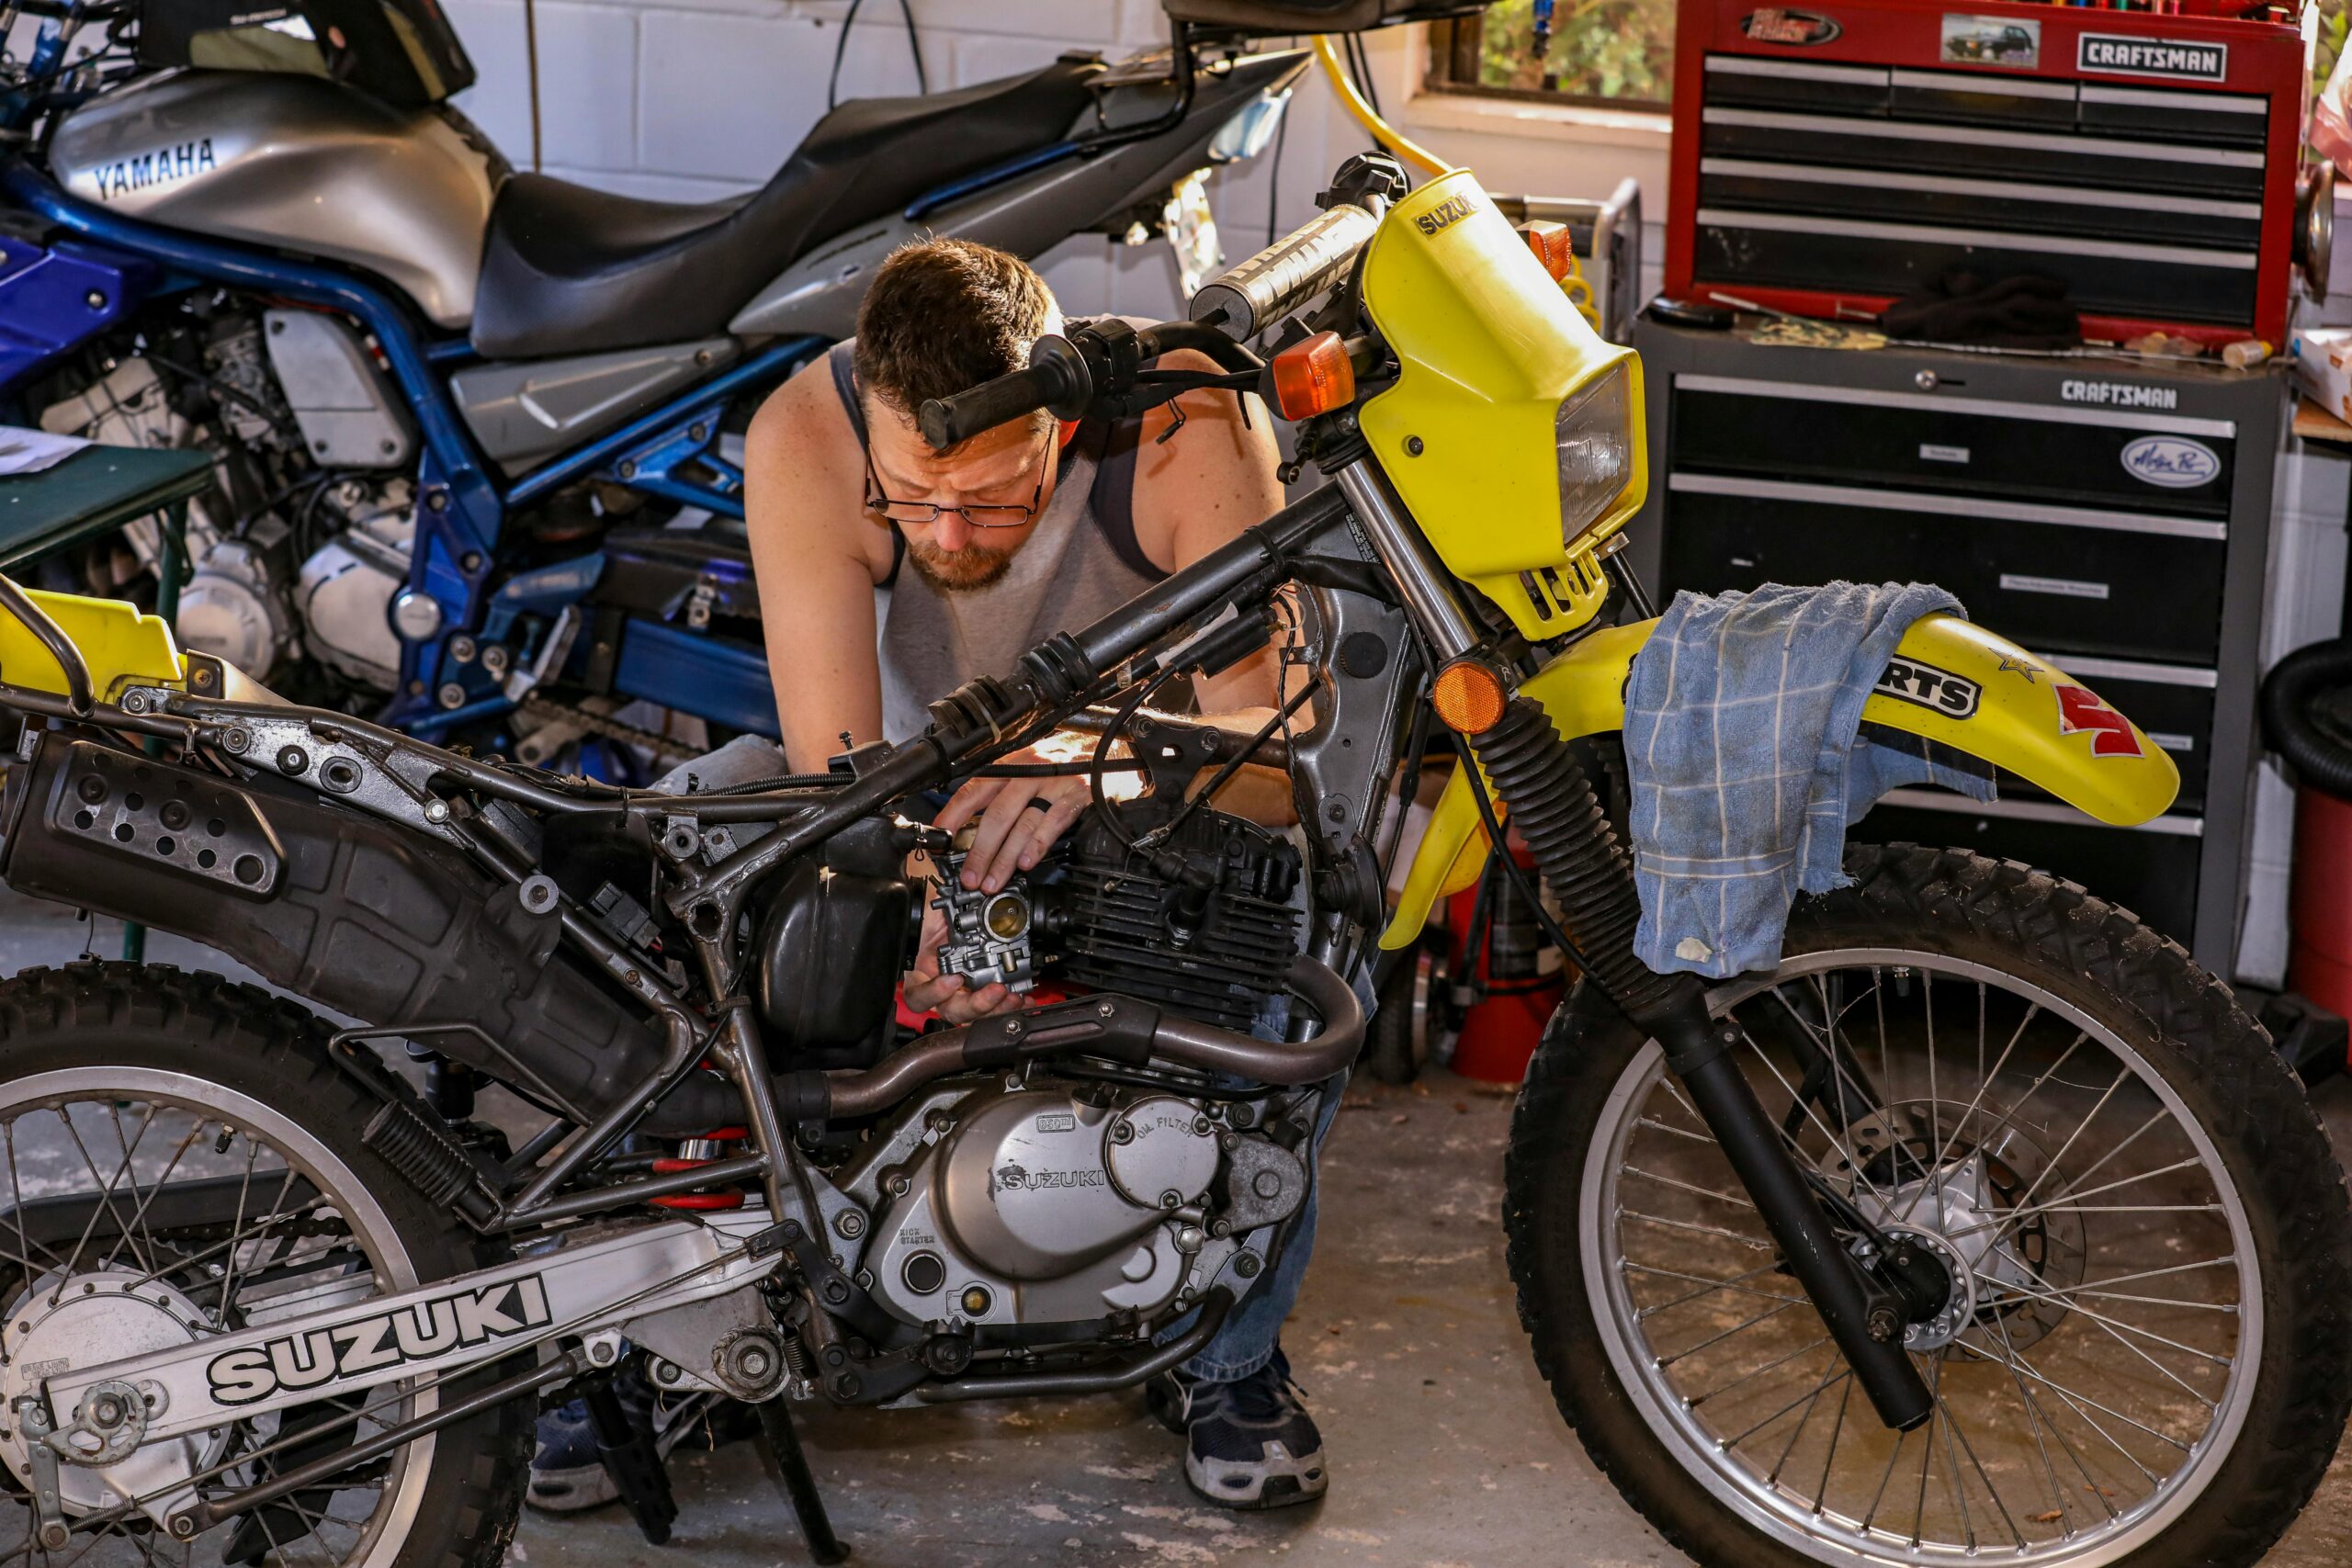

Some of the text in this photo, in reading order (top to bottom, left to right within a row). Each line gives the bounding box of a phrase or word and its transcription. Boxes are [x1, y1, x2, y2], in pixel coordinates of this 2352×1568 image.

[2087, 42, 2218, 73] CRAFTSMAN
[95, 138, 216, 201] YAMAHA
[2061, 379, 2177, 410] CRAFTSMAN
[1156, 1116, 1194, 1139] FILTER
[1004, 1169, 1105, 1190] SUZUKI
[206, 1272, 552, 1405] SUZUKI
